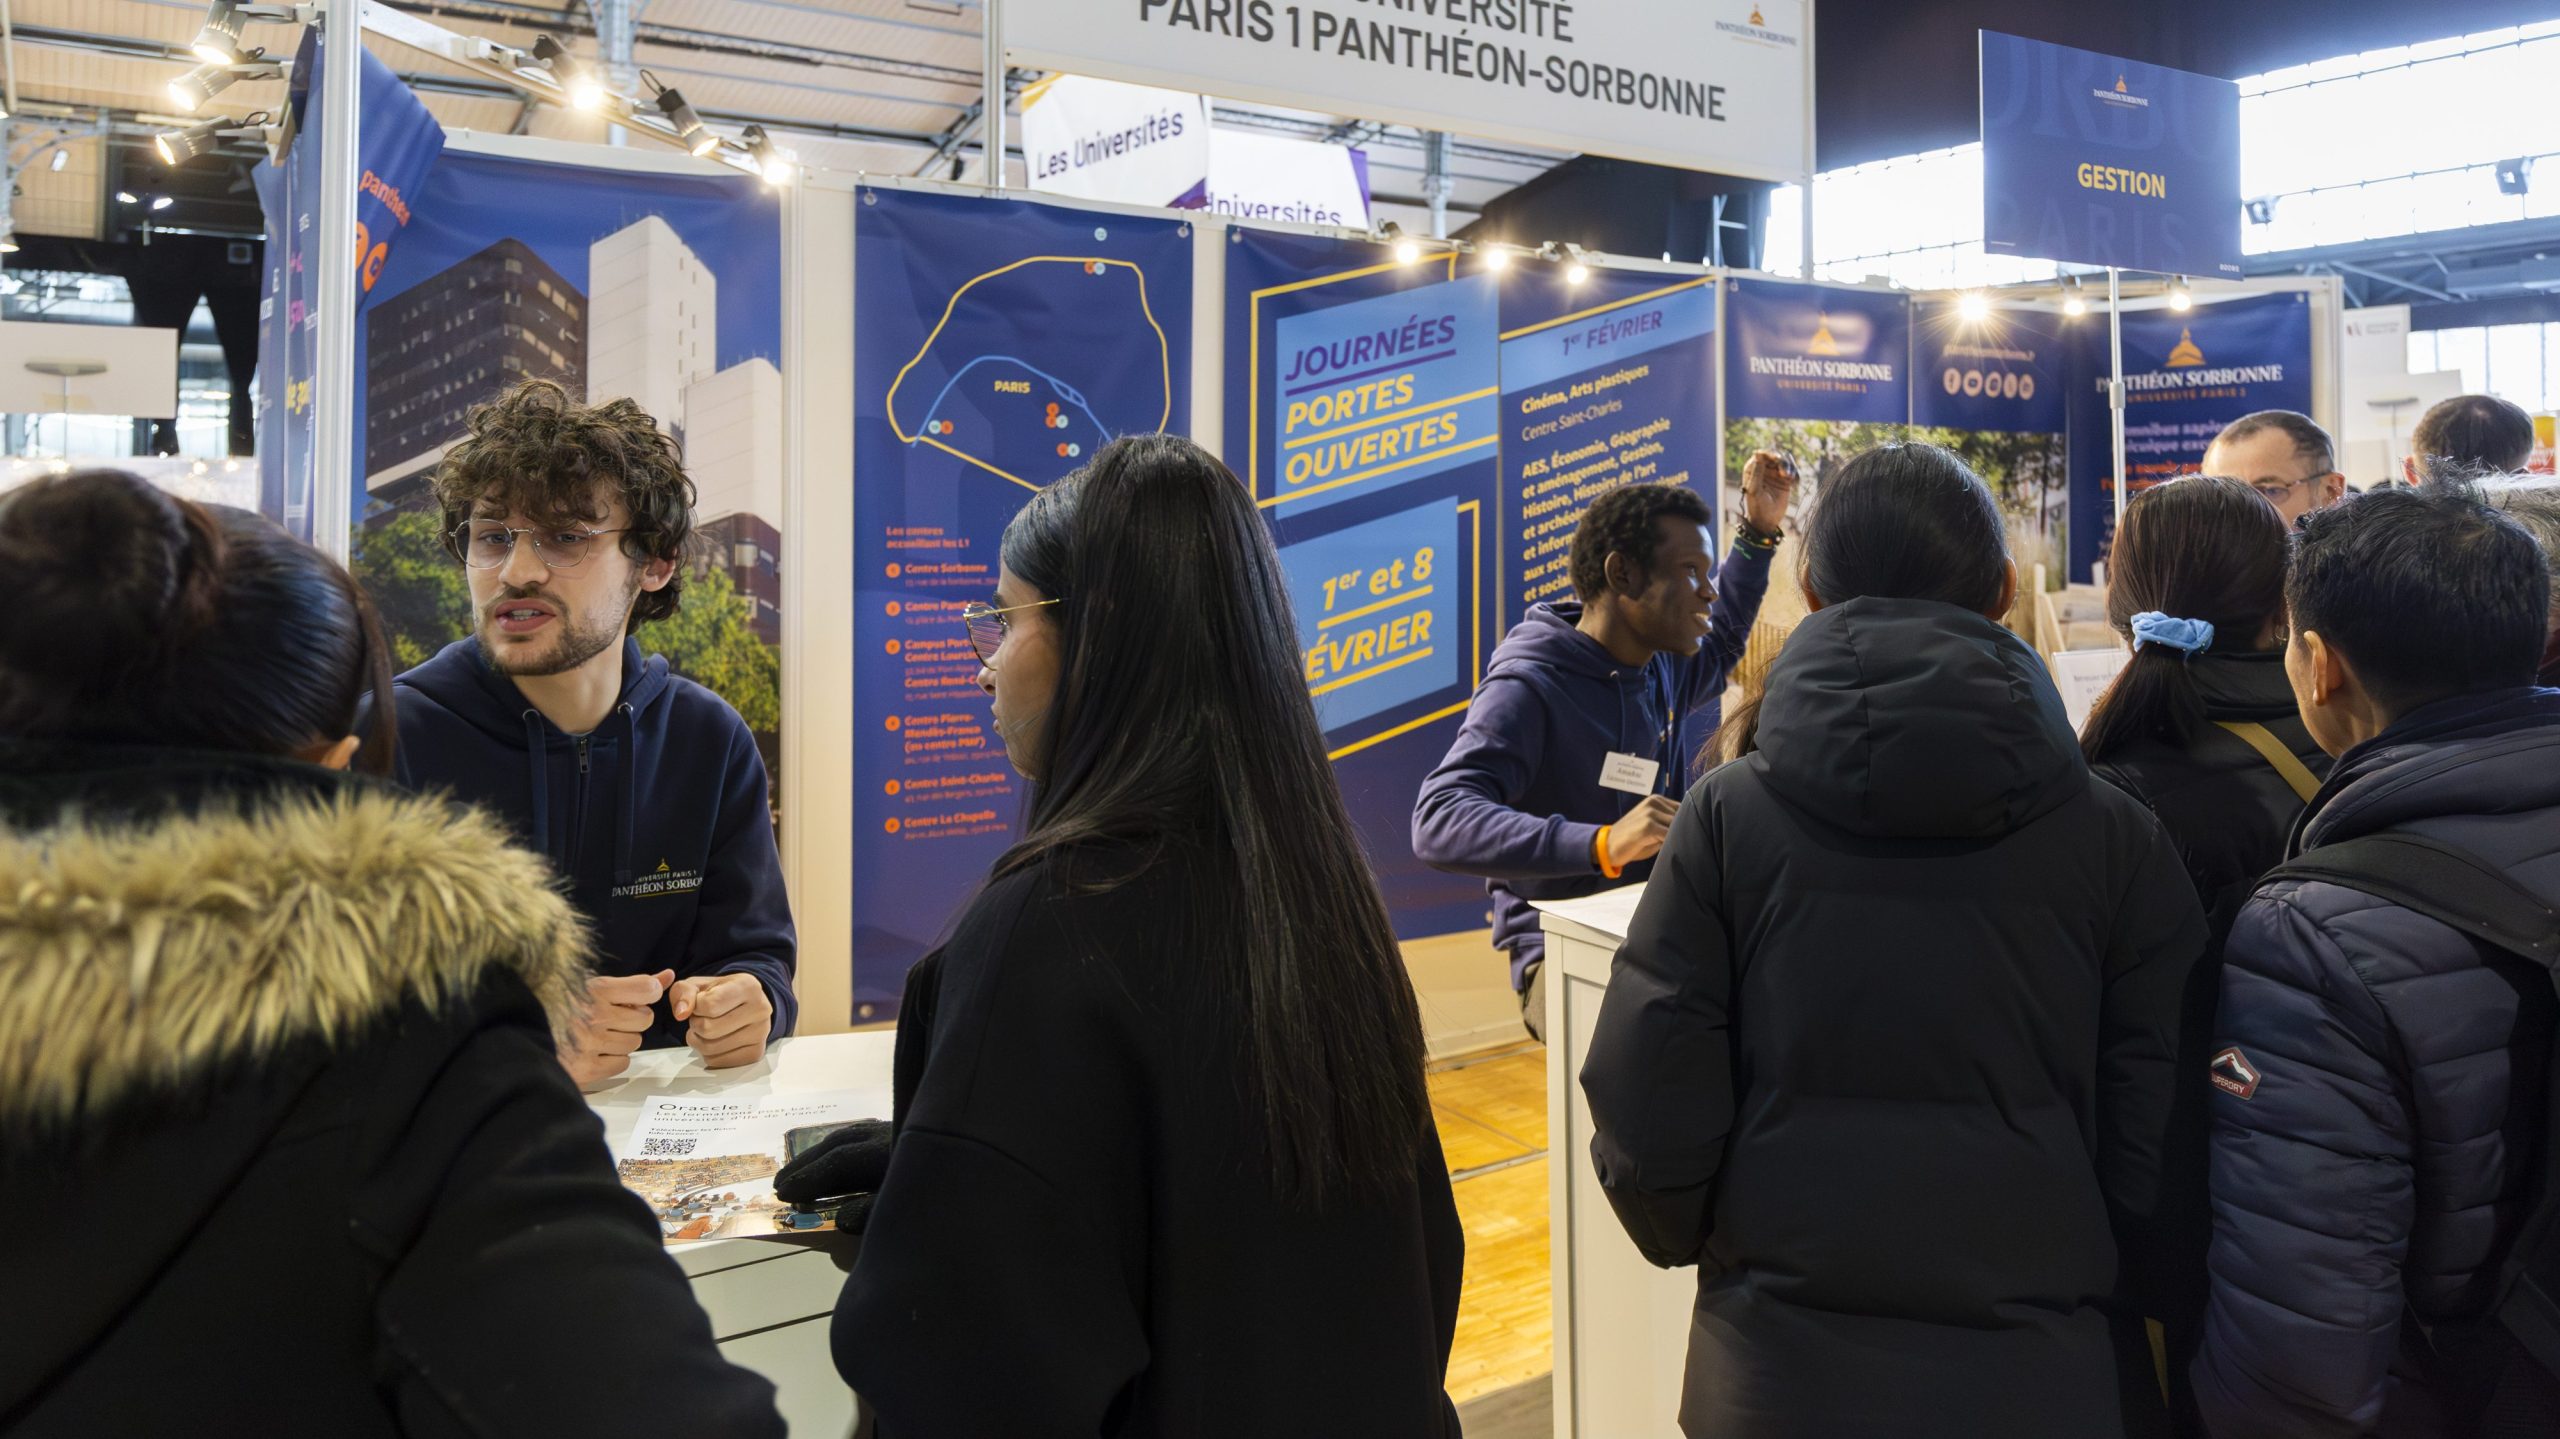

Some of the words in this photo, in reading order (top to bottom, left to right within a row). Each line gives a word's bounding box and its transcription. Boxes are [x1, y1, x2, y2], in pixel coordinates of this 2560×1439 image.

[1355, 0, 1574, 43] ERSITÉ
[1286, 7, 1300, 48] 1
[1312, 11, 1727, 122] PANTHÉON-SORBONNE
[1037, 155, 1068, 180] Les
[1074, 106, 1185, 169] Universités
[2077, 162, 2166, 199] GESTION
[1284, 314, 1456, 382] JOURNÉES
[1586, 310, 1664, 349] FÉVRIER
[994, 381, 1031, 394] PARIS
[1750, 356, 1823, 378] PANTHÉON
[1824, 360, 1893, 382] SORBONNE
[2186, 364, 2283, 387] SORBONNE
[1285, 373, 1414, 424] PORTES
[1521, 391, 1568, 414] Cinéma,
[1569, 382, 1593, 399] Arts
[1595, 364, 1649, 394] plastiques
[1522, 419, 1558, 442] Centre
[1559, 400, 1623, 430] Saint-Charles
[1285, 412, 1458, 485] OUVERTES
[1522, 458, 1550, 479] AES,
[1551, 439, 1609, 469] Économie,
[1610, 416, 1671, 448] Géographie
[1522, 485, 1535, 499] et
[1523, 494, 1573, 520] Histoire,
[1523, 526, 1536, 540] et
[1523, 546, 1537, 561] et
[1323, 569, 1362, 612] 1er
[1369, 557, 1405, 596] et
[1411, 546, 1434, 582] 8
[1524, 565, 1545, 582] aux
[1524, 586, 1537, 602] et
[1302, 610, 1433, 682] ÉVRIER
[666, 877, 703, 891] SORBO
[659, 1103, 739, 1111] Oraccle
